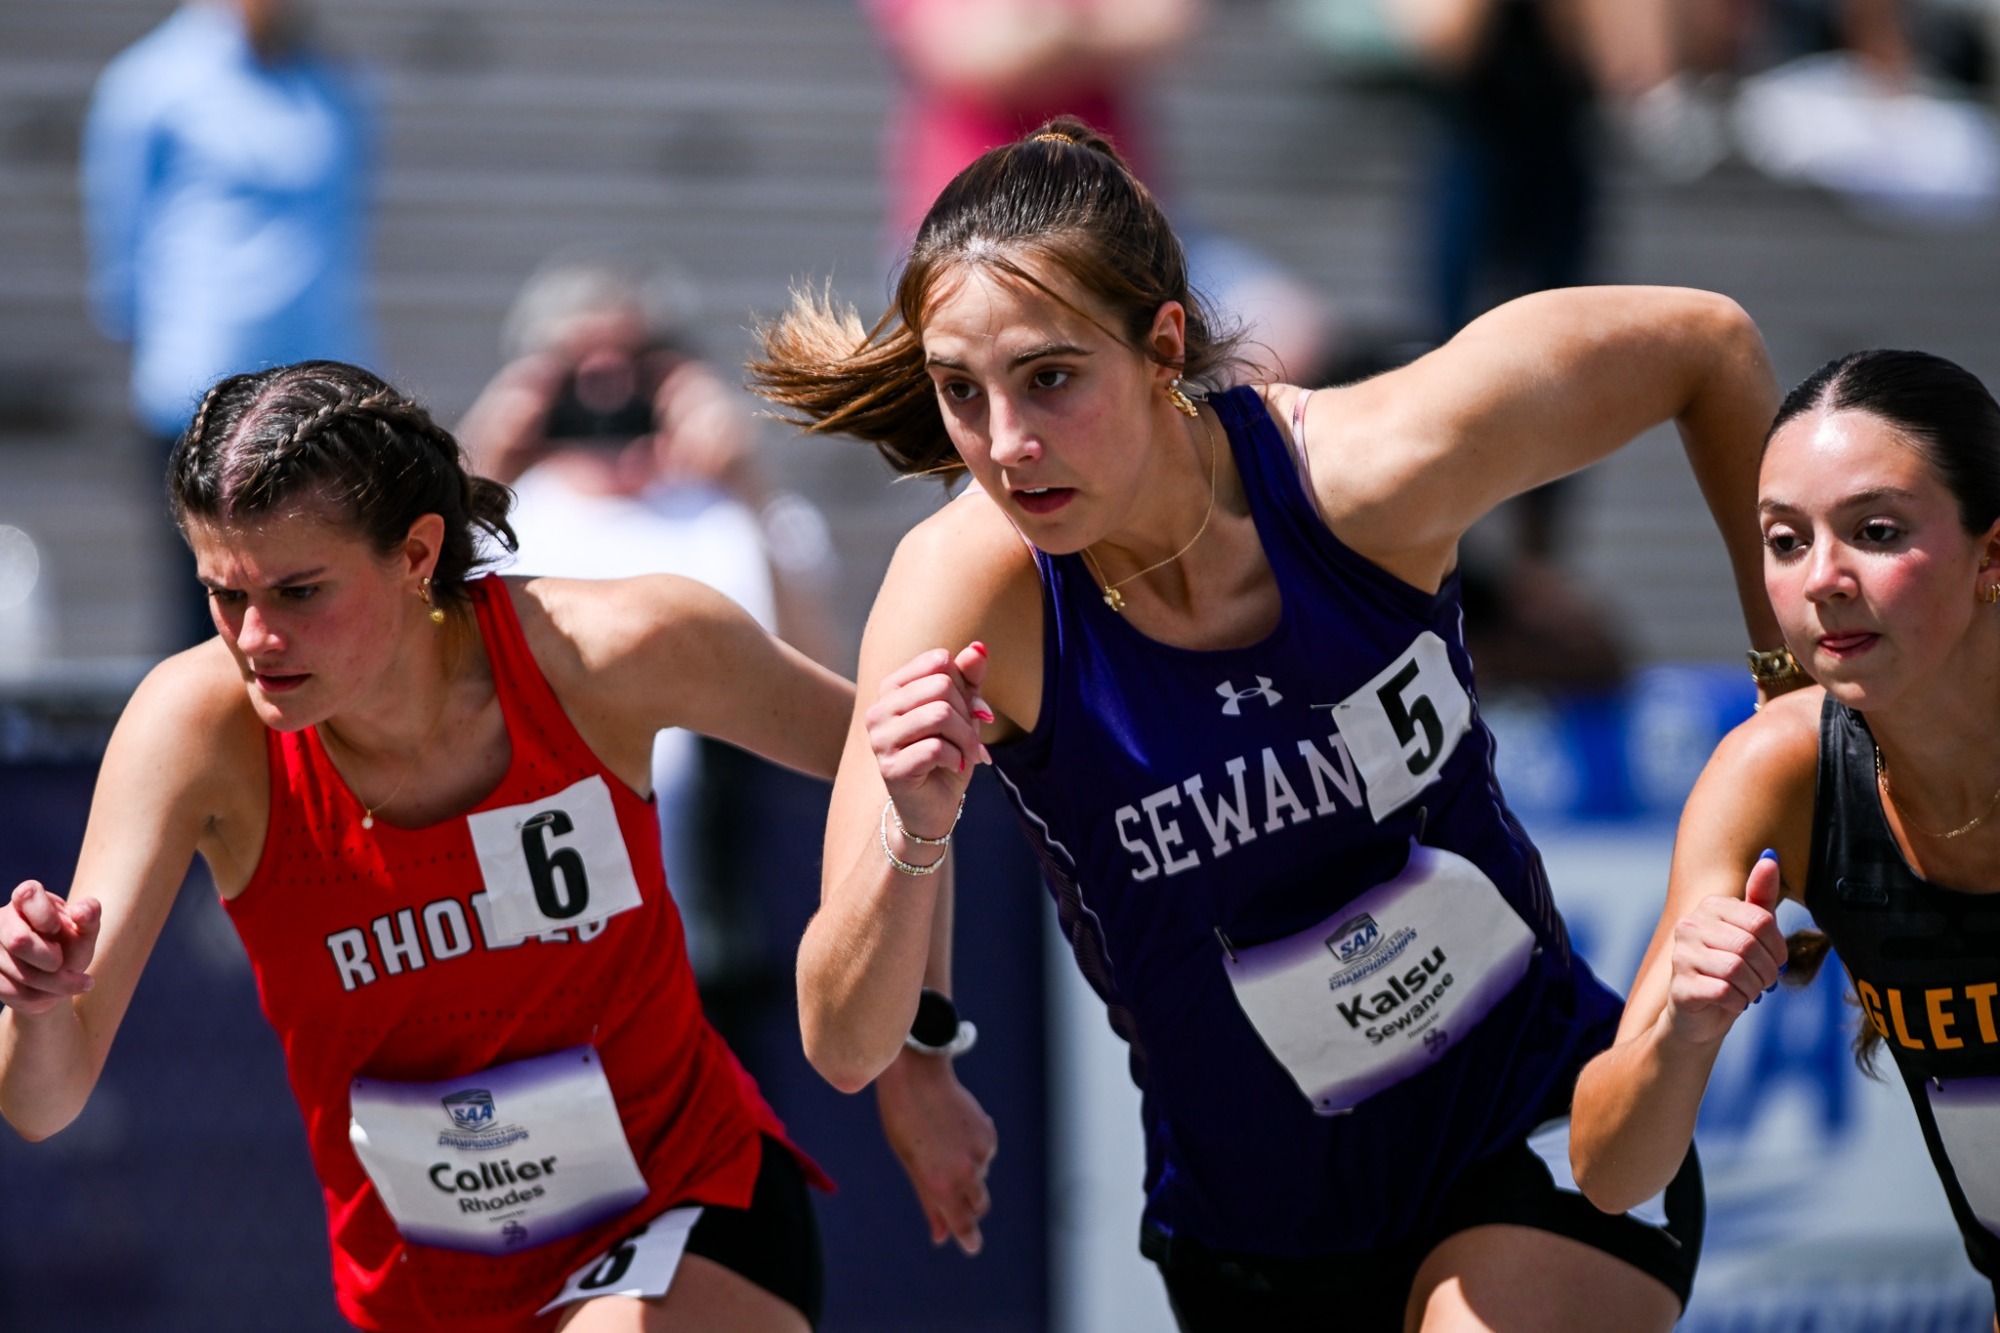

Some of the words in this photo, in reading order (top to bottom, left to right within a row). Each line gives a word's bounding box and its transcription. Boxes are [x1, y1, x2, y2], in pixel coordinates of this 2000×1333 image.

[1376, 657, 1444, 776] 5
[1115, 732, 1364, 881] SEWAN
[521, 809, 590, 920] 6
[326, 890, 608, 992] RHO
[1329, 928, 1418, 991] CHAMPIONSHIPS
[1339, 922, 1379, 957] SAA
[1336, 945, 1447, 1029] Kalsu
[1364, 972, 1454, 1046] Sewanee
[1850, 972, 2000, 1051] GLET
[437, 1130, 530, 1149] CHAMPIONSHIPS
[454, 1103, 493, 1122] SAA
[428, 1155, 558, 1194] Collier
[458, 1184, 546, 1214] Rhodes
